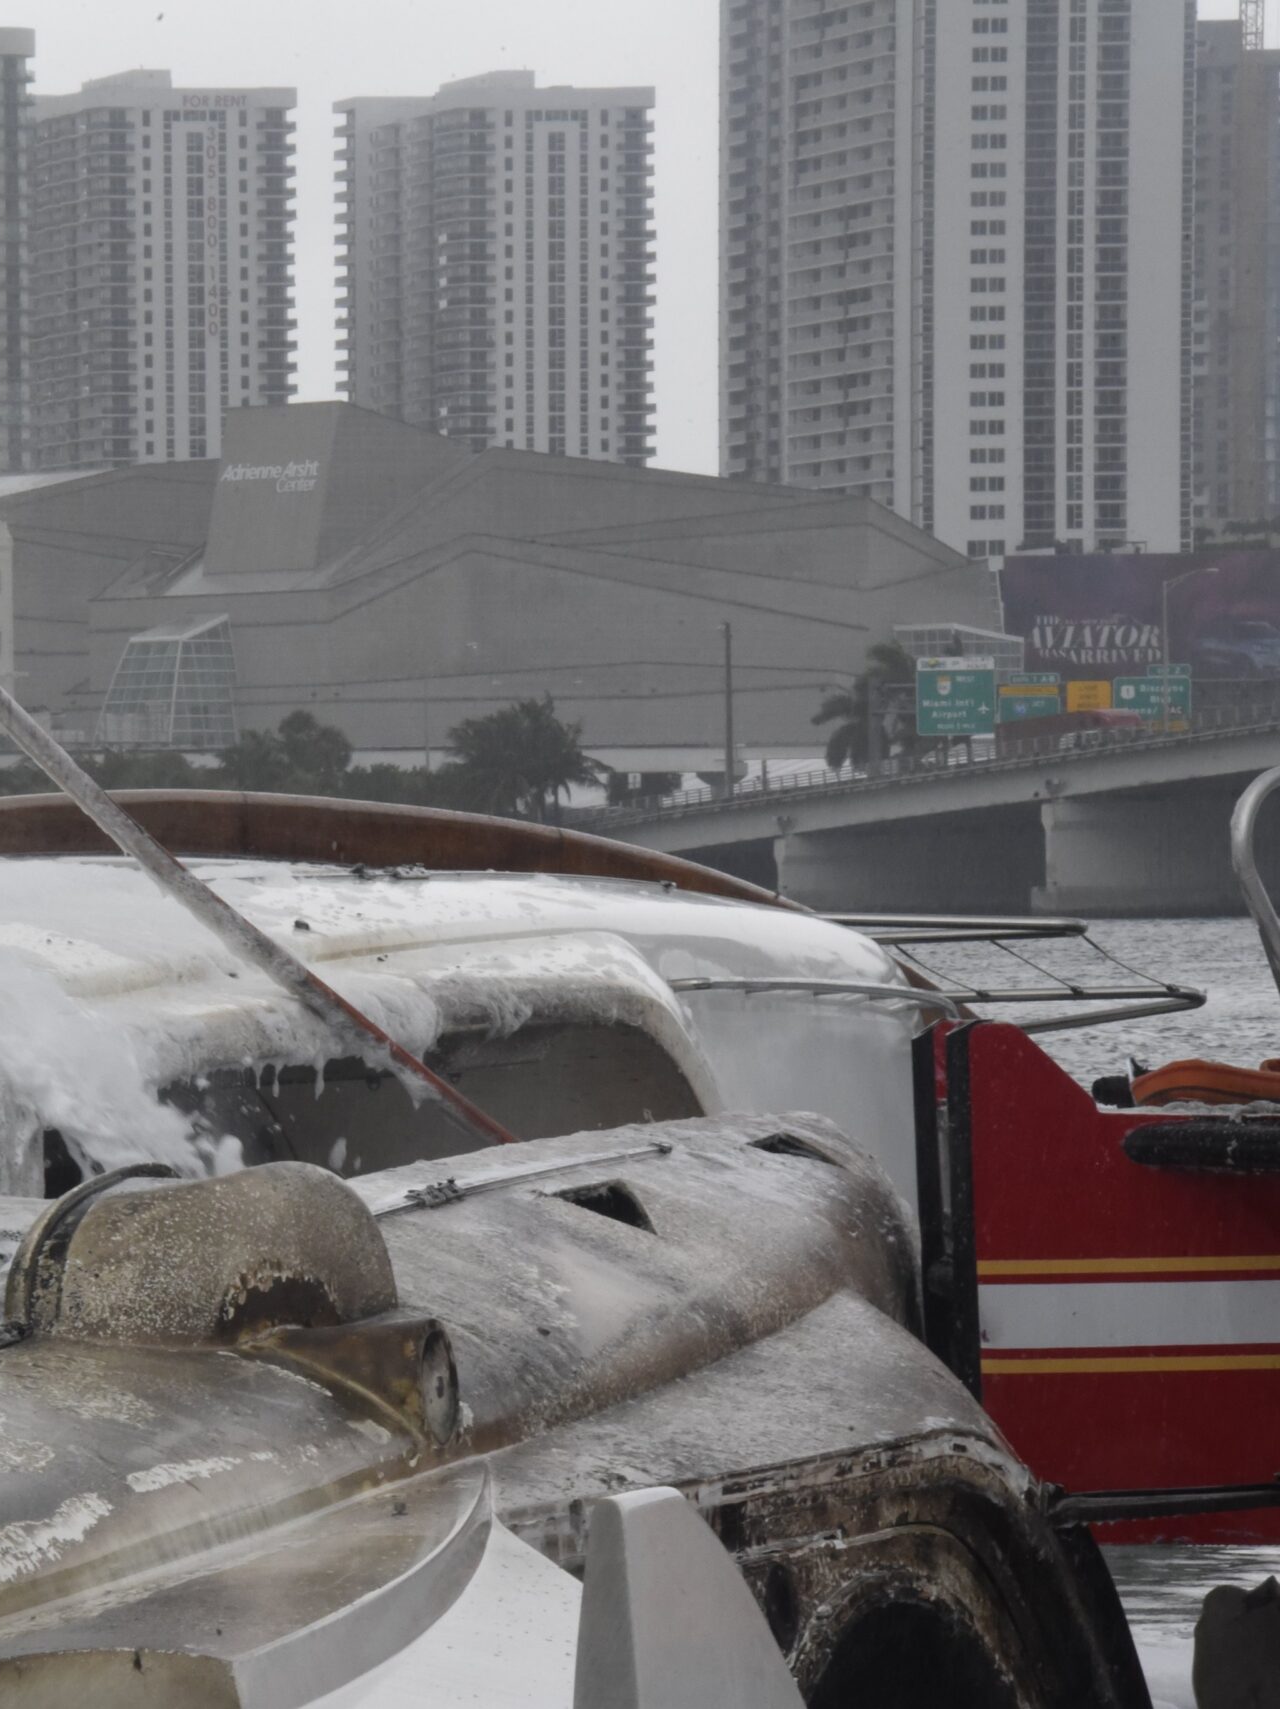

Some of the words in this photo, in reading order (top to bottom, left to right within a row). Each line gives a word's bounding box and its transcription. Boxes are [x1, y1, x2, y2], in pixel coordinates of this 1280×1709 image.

[182, 94, 208, 107] FOR
[214, 94, 247, 107] RENT
[220, 463, 282, 482] Adrienne
[280, 459, 319, 479] Arsht
[276, 477, 318, 493] Center
[1032, 624, 1161, 648] AVIATOR
[1070, 648, 1162, 664] ARRIVED
[922, 699, 951, 707] Miami
[931, 710, 967, 719] Airport
